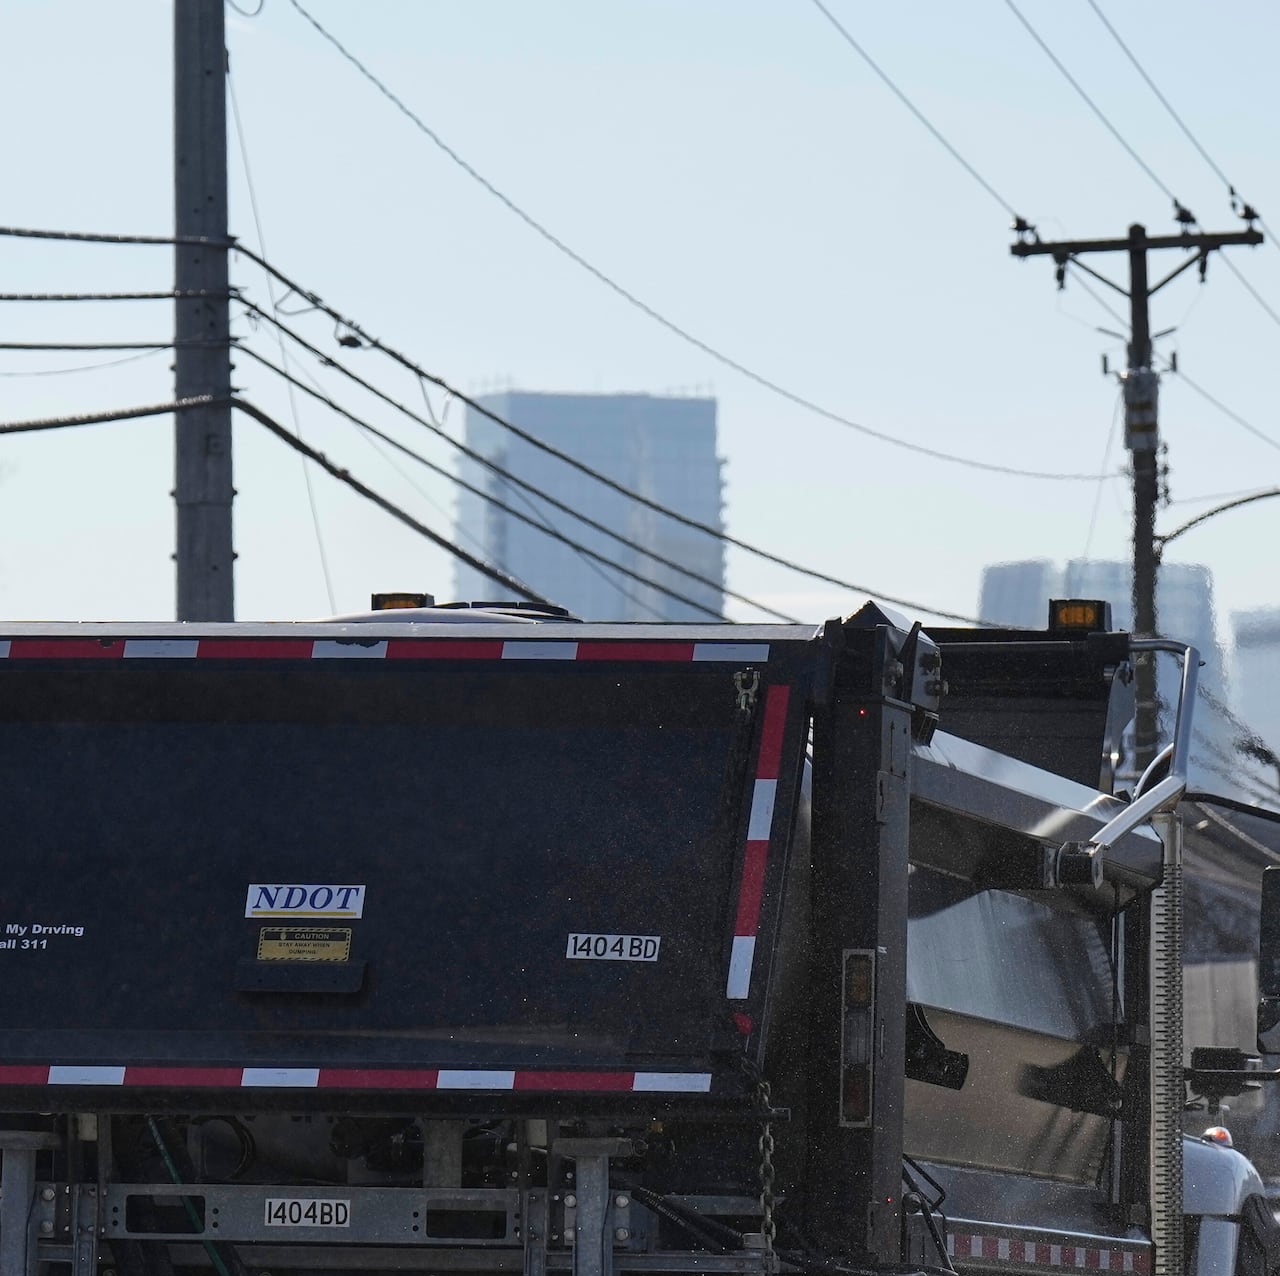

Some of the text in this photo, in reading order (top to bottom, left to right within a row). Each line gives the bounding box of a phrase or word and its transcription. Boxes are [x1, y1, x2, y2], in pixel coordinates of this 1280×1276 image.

[252, 886, 360, 909] NDOT
[6, 923, 28, 936] My
[32, 924, 84, 936] Driving
[20, 939, 48, 949] 311
[572, 936, 658, 958] 1404BD
